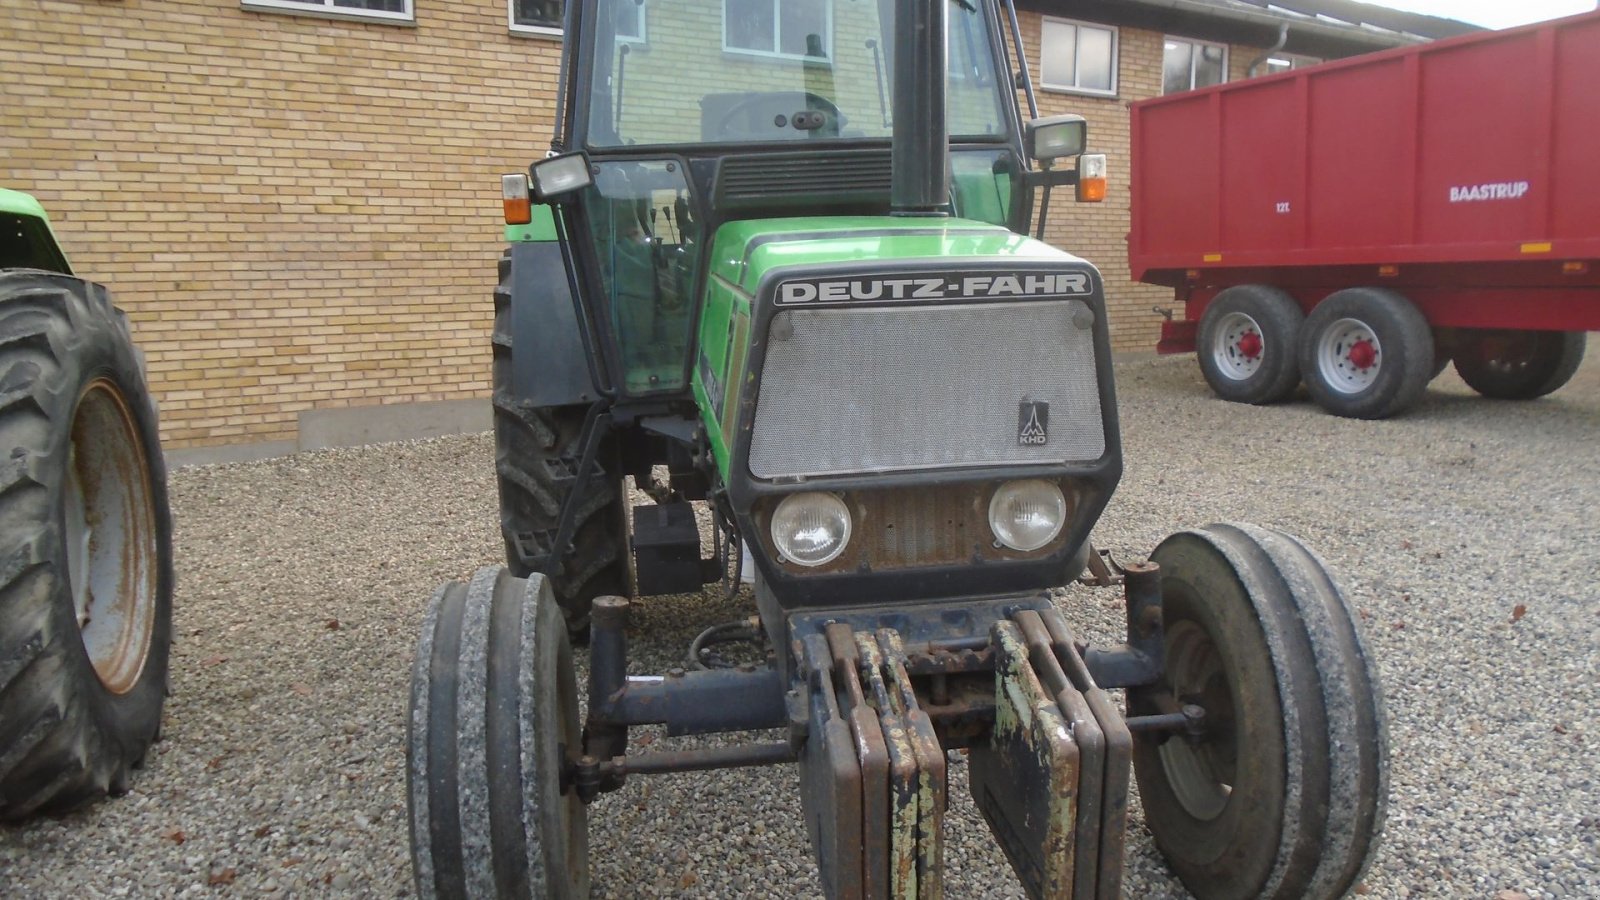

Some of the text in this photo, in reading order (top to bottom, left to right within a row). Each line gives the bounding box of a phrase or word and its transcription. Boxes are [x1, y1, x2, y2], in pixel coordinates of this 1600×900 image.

[1450, 181, 1528, 202] BAASTRUP
[782, 274, 1086, 302] DEUTZ-FAHR
[1020, 435, 1046, 444] KHD
